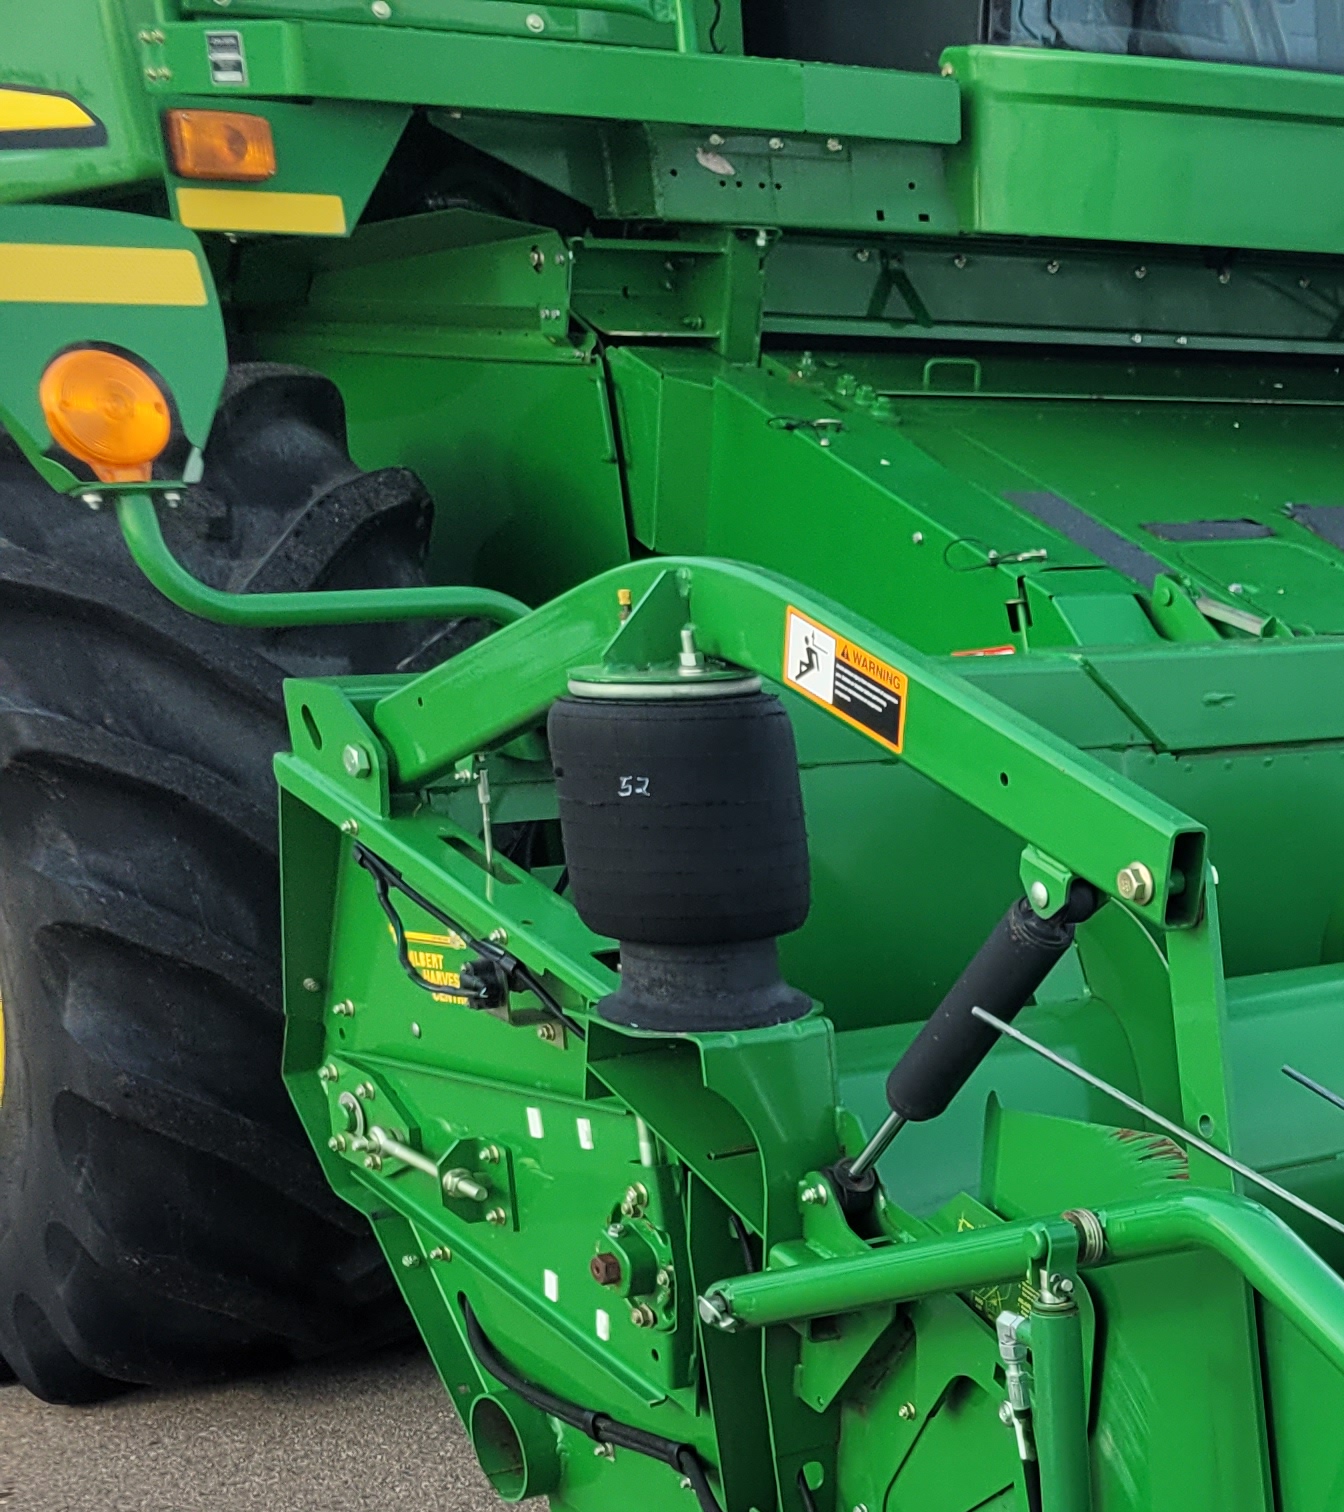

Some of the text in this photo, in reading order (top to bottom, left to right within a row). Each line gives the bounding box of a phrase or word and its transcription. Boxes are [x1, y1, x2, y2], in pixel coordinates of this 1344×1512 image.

[852, 649, 901, 690] WARNING
[617, 775, 651, 797] 52
[423, 970, 460, 989] HARVES
